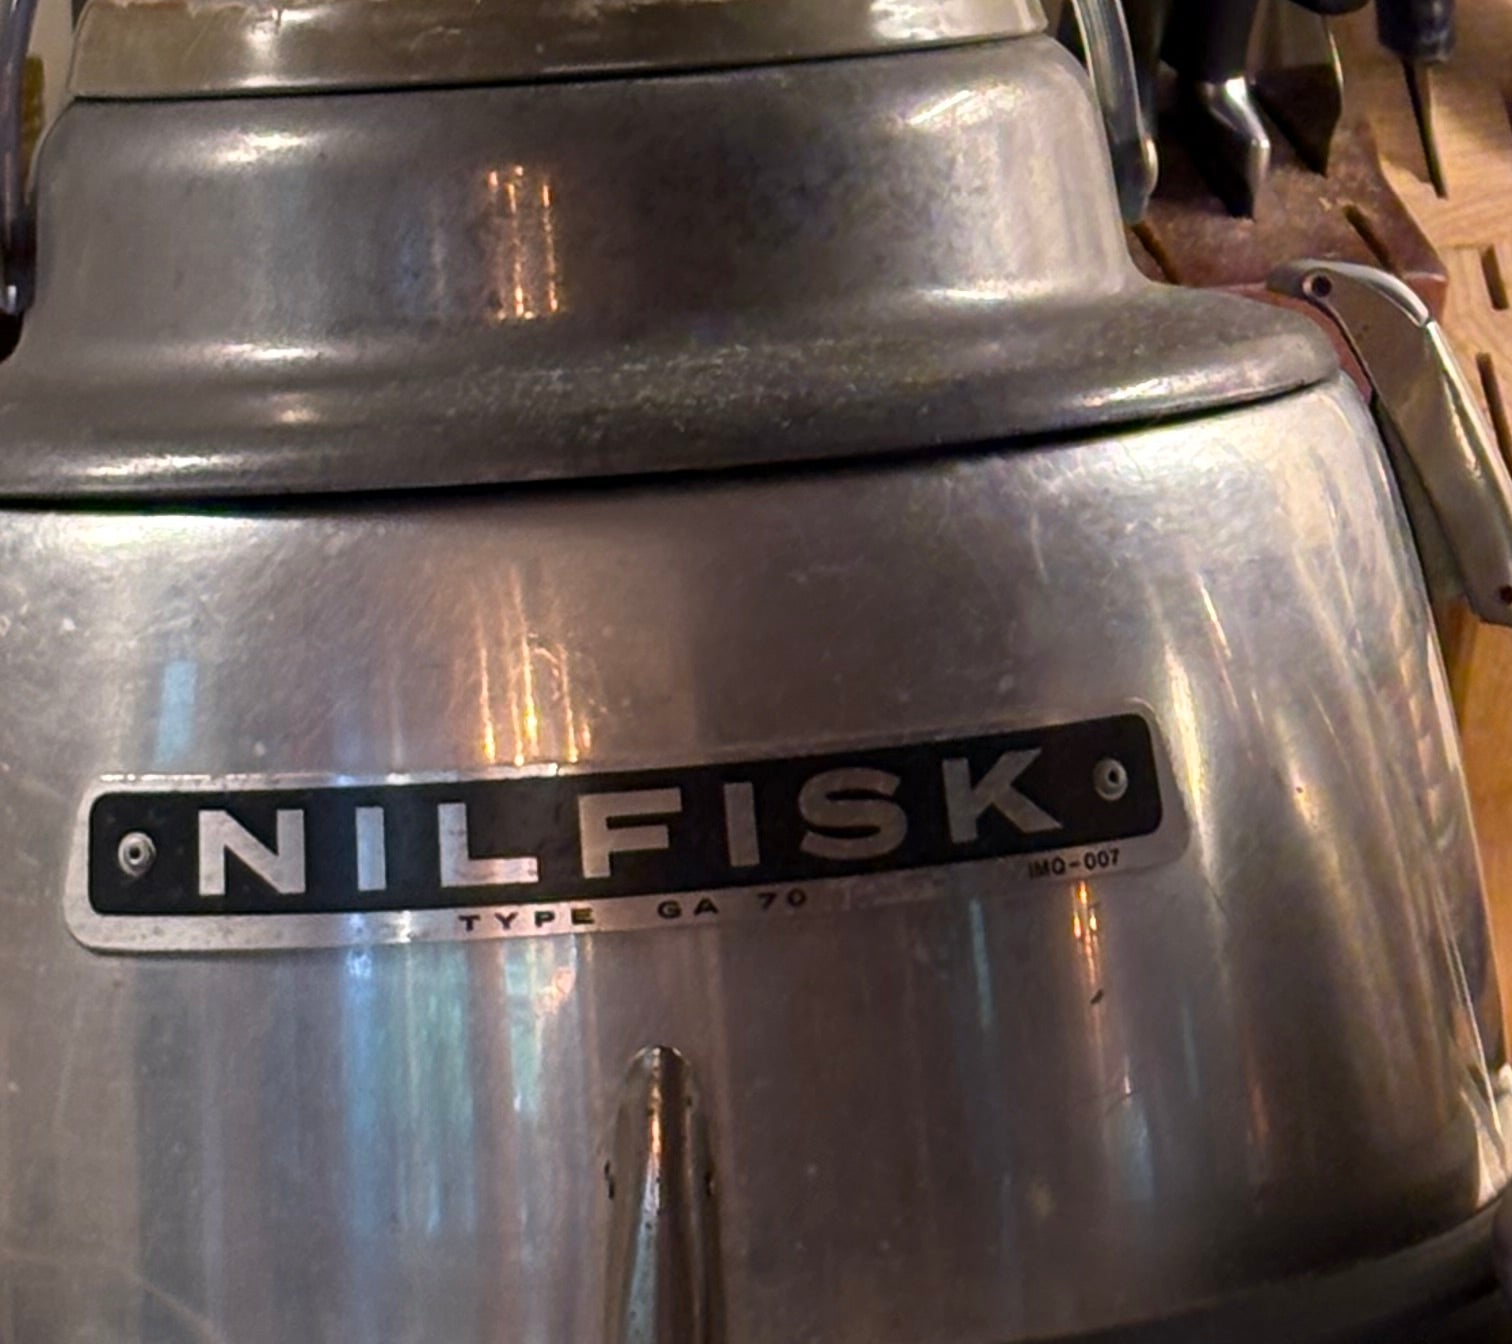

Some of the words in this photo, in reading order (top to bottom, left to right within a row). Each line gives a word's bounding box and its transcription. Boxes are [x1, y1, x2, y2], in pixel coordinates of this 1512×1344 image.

[199, 748, 1062, 897] NILFISK
[458, 906, 596, 932] TYPE
[656, 896, 719, 920] GA
[757, 888, 807, 912] 70
